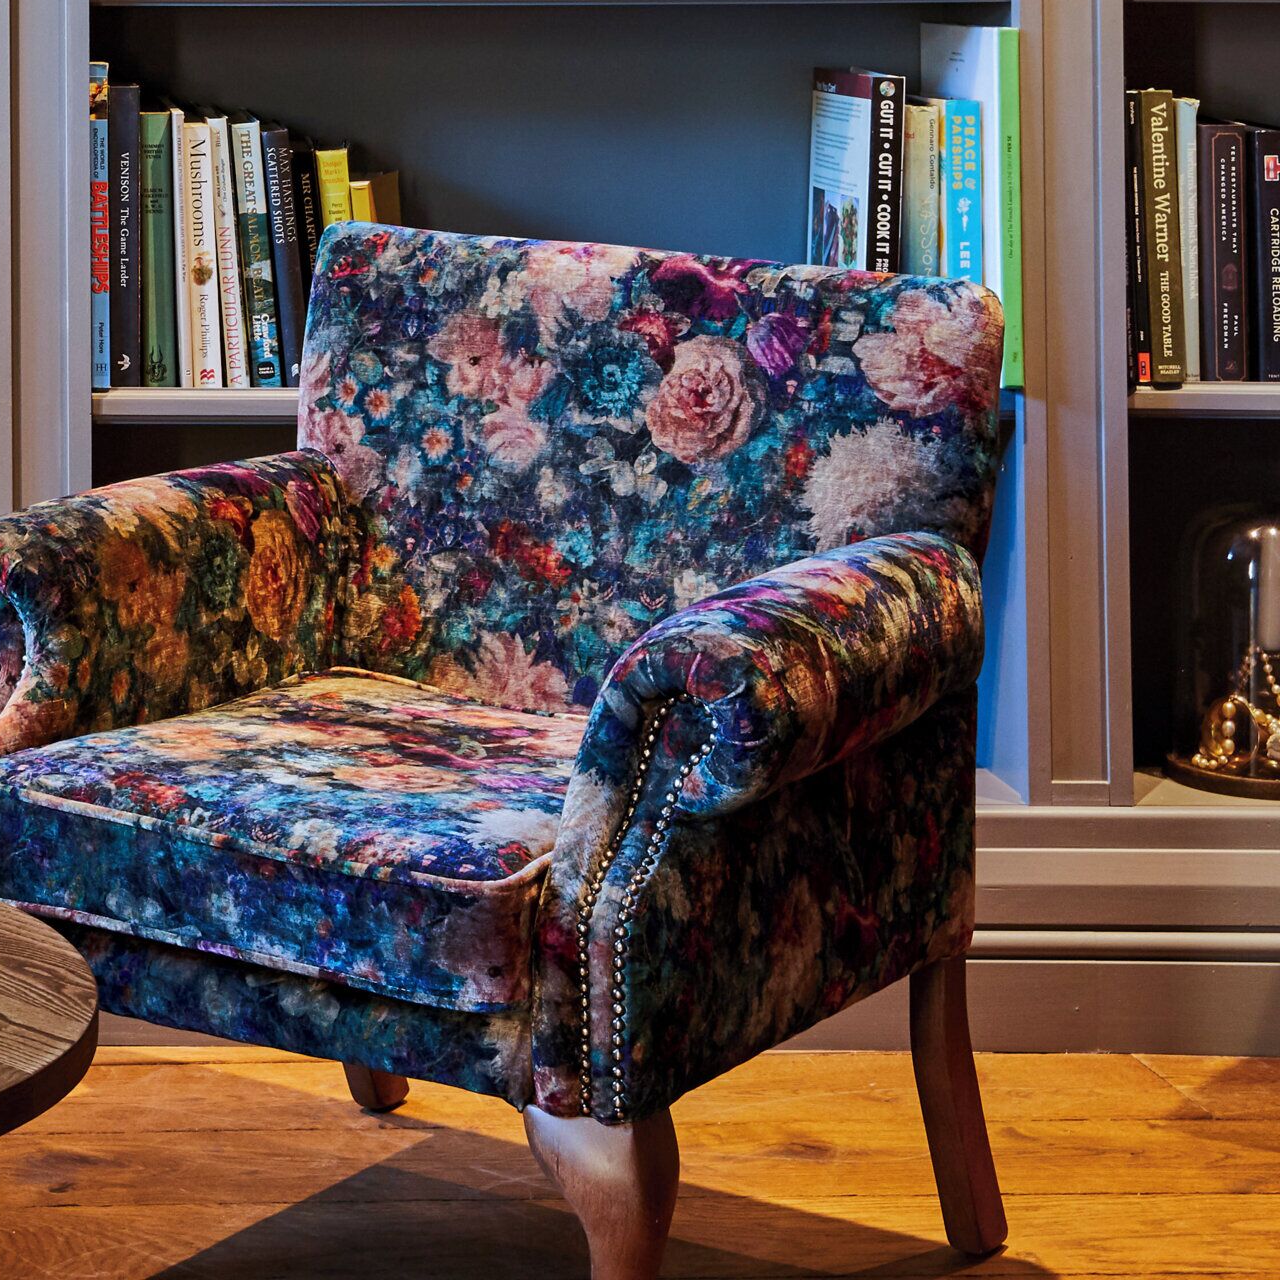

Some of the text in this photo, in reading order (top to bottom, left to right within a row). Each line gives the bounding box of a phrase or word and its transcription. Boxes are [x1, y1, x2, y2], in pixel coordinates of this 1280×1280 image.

[120, 152, 129, 288] VENISON The Game Larder
[188, 138, 207, 248] Mushrooms
[267, 147, 284, 244] SCATTERED SHOTS
[279, 147, 297, 243] MAX HASTINGS
[877, 99, 895, 254] GUT IT CUT IT COOK IT
[1150, 102, 1172, 263] Valentine Warner
[91, 181, 110, 294] BATTLESHIPS
[1270, 207, 1280, 343] CARTRIDGE RELOADING
[199, 293, 210, 359] Roger Phillips
[218, 225, 242, 385] A PARTICULAR LUNN
[252, 314, 261, 341] Little
[258, 313, 270, 358] Crawford
[1159, 271, 1173, 358] THE GOOD TABLE
